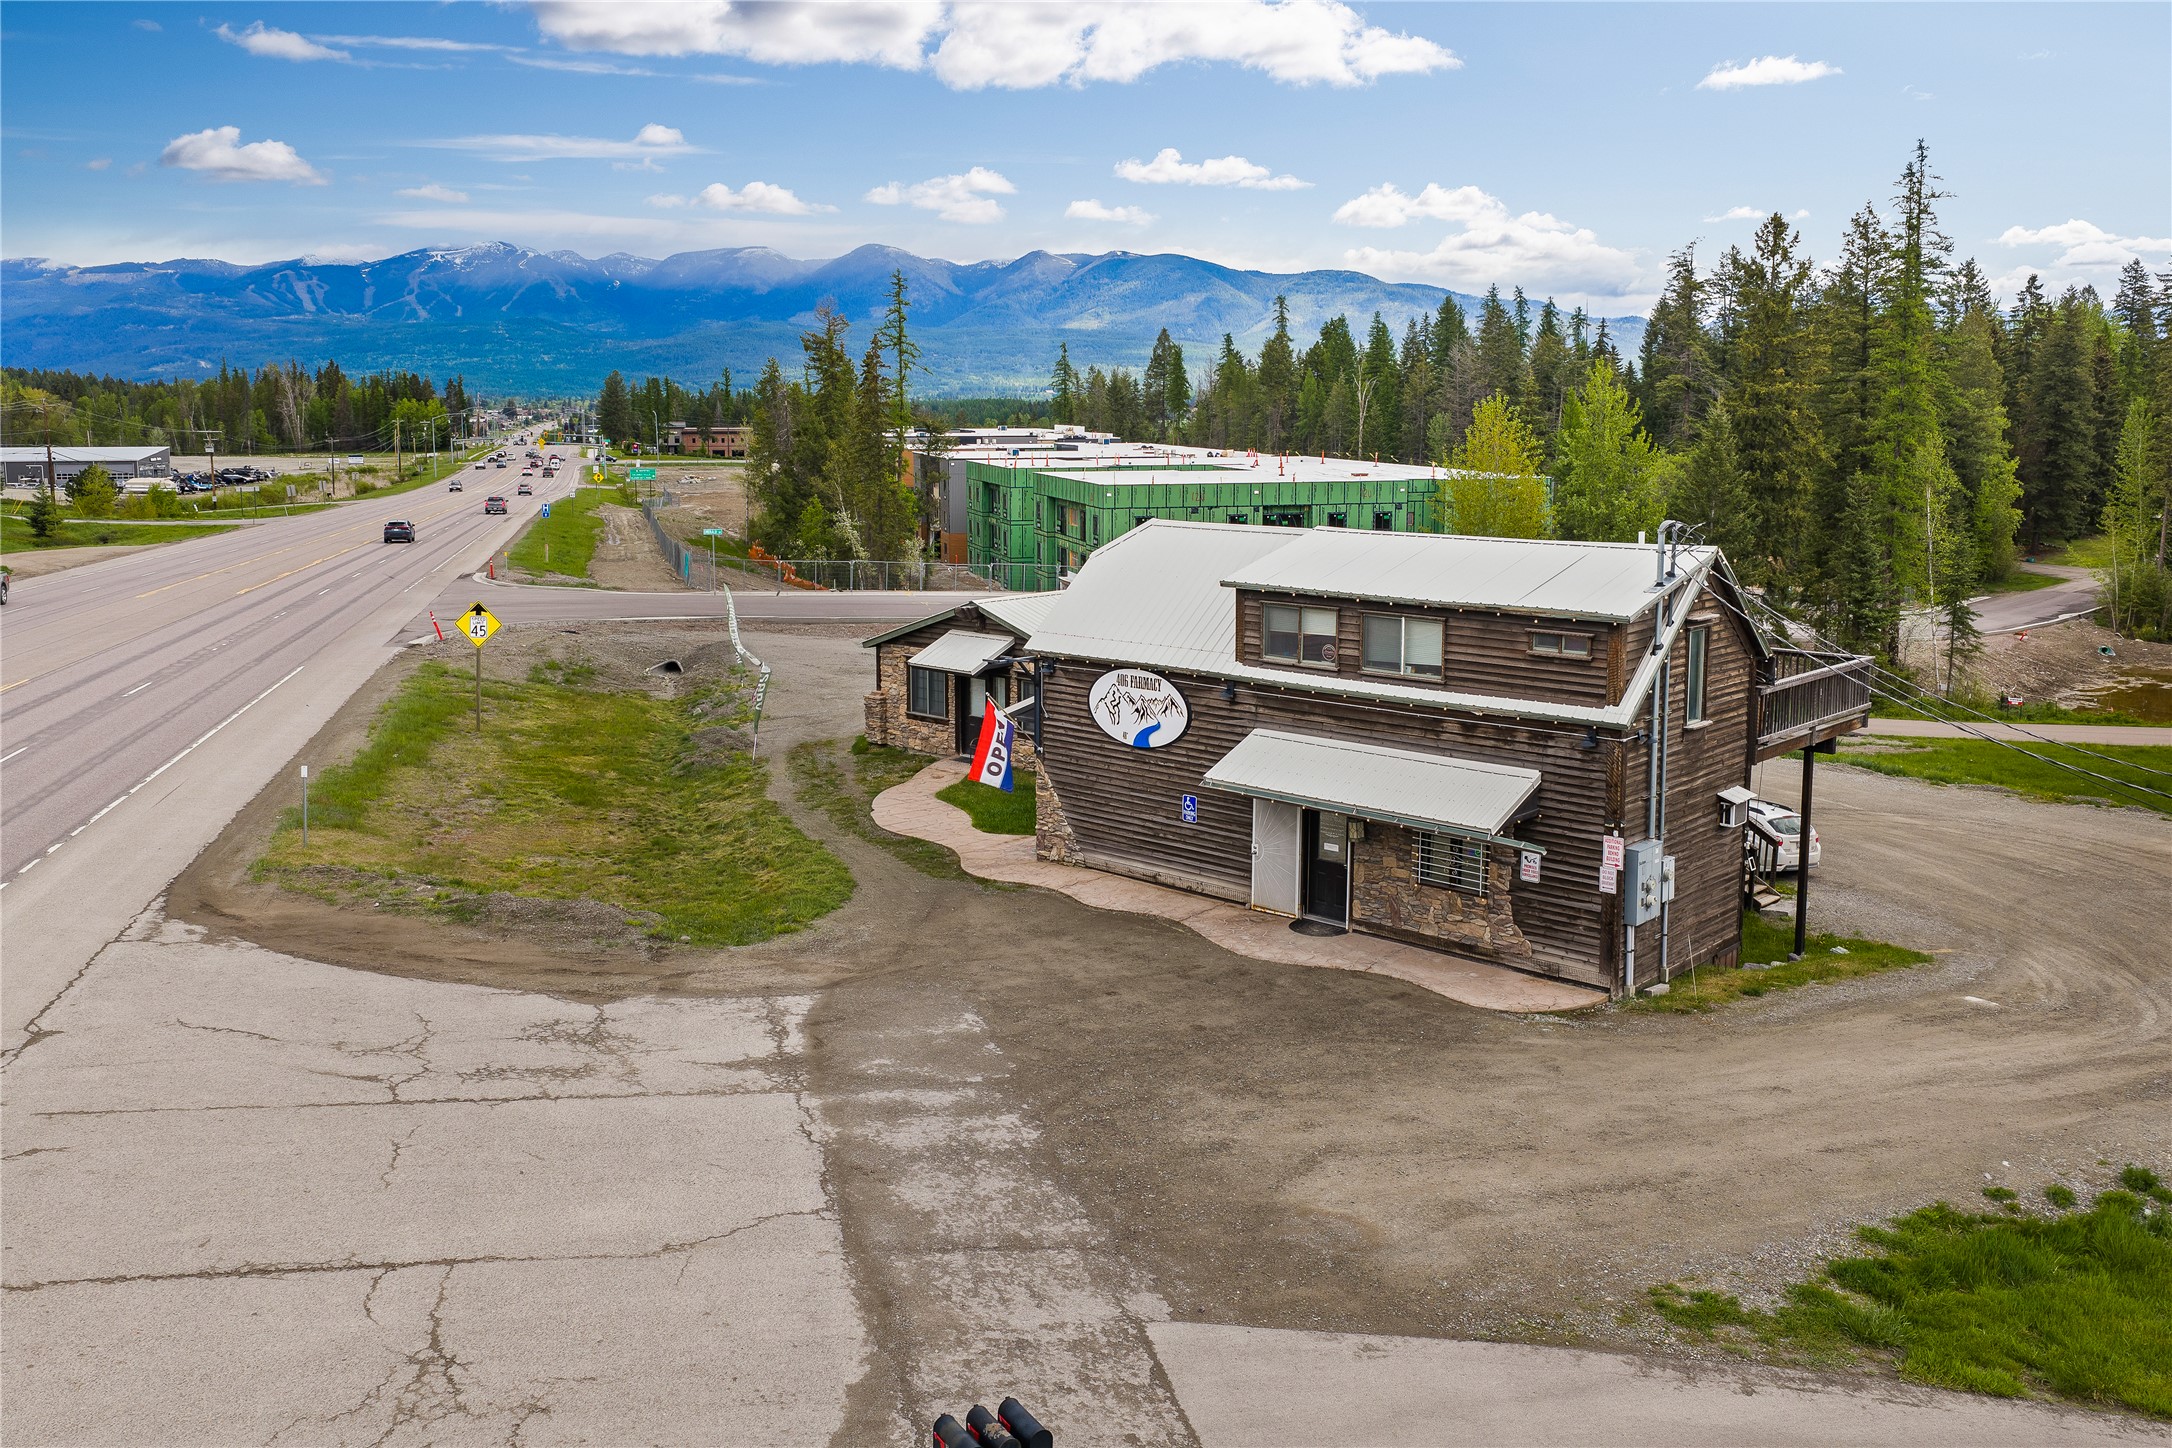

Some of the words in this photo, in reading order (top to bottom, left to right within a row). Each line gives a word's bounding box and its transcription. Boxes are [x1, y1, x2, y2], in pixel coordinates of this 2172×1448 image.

[471, 625, 486, 637] 45
[1116, 673, 1128, 687] 406
[1130, 675, 1162, 692] FARMACY
